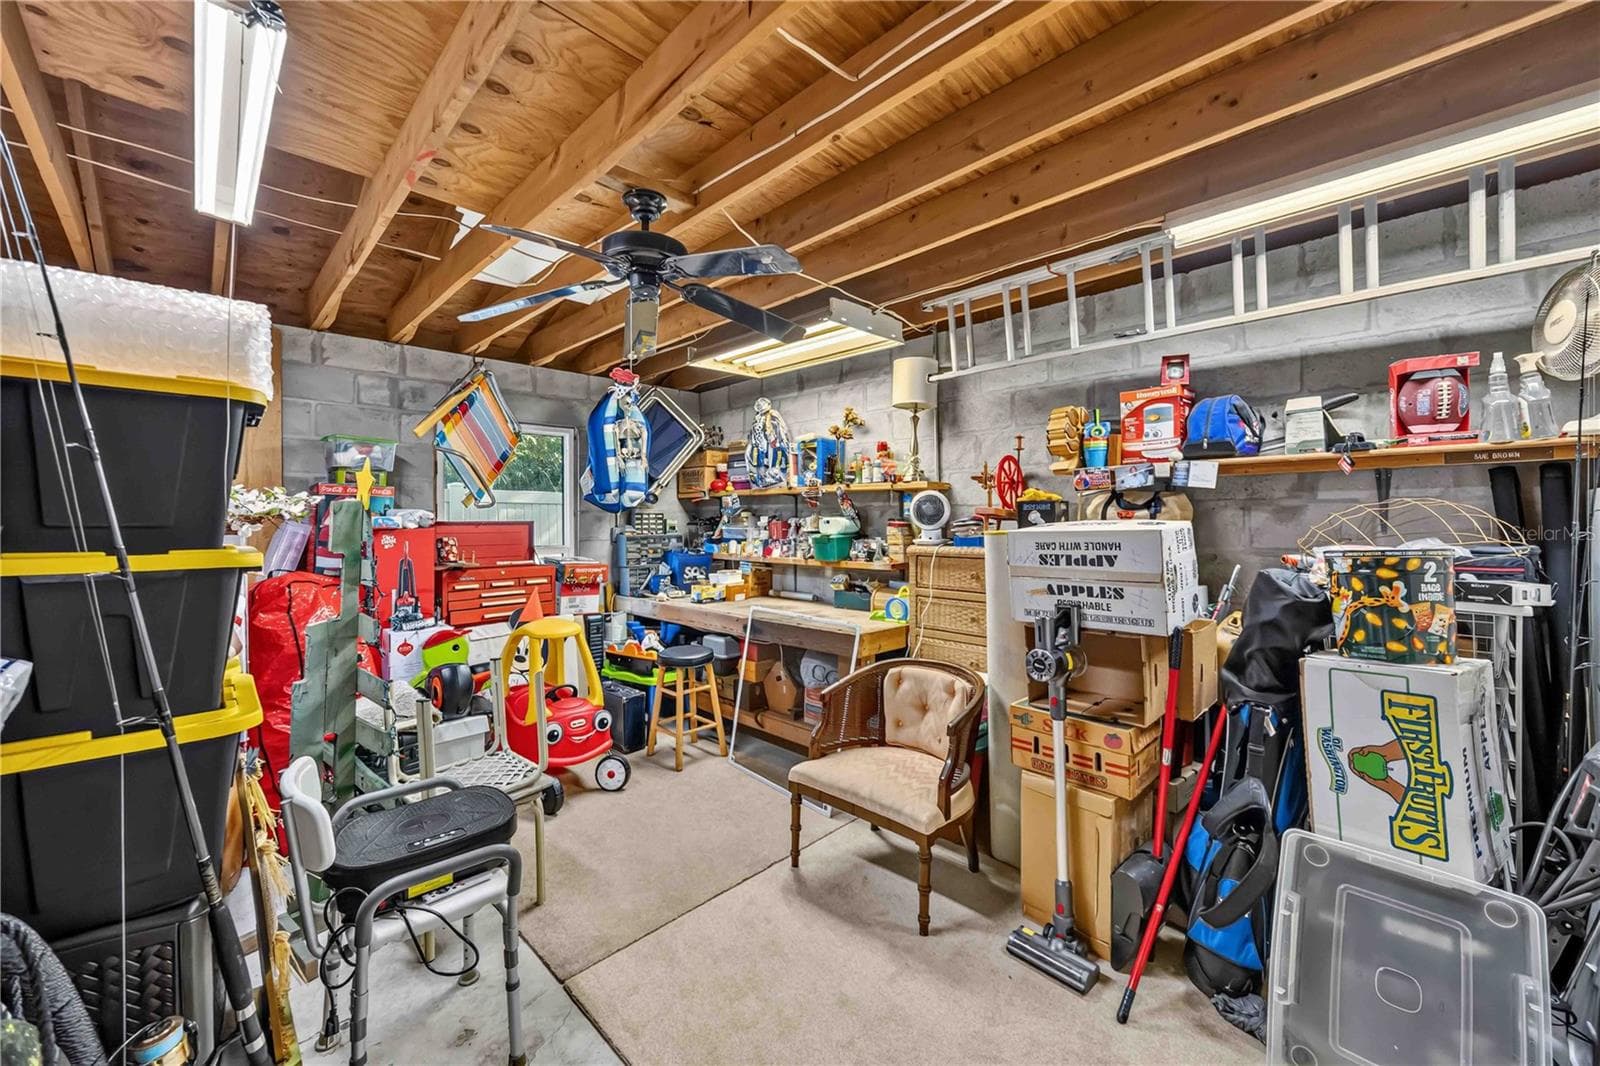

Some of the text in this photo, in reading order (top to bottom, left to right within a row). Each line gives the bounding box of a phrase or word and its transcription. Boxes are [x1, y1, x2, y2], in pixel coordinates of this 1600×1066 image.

[1035, 541, 1122, 551] HANDLE WITH CARE
[1038, 553, 1118, 567] APPLES
[1423, 561, 1437, 582] 2
[1046, 583, 1125, 600] APPLES
[1421, 583, 1441, 592] BAGS
[1418, 592, 1445, 602] INSIDE
[1321, 729, 1346, 793] WASHINGTON
[1462, 747, 1483, 859] PREMIUM
